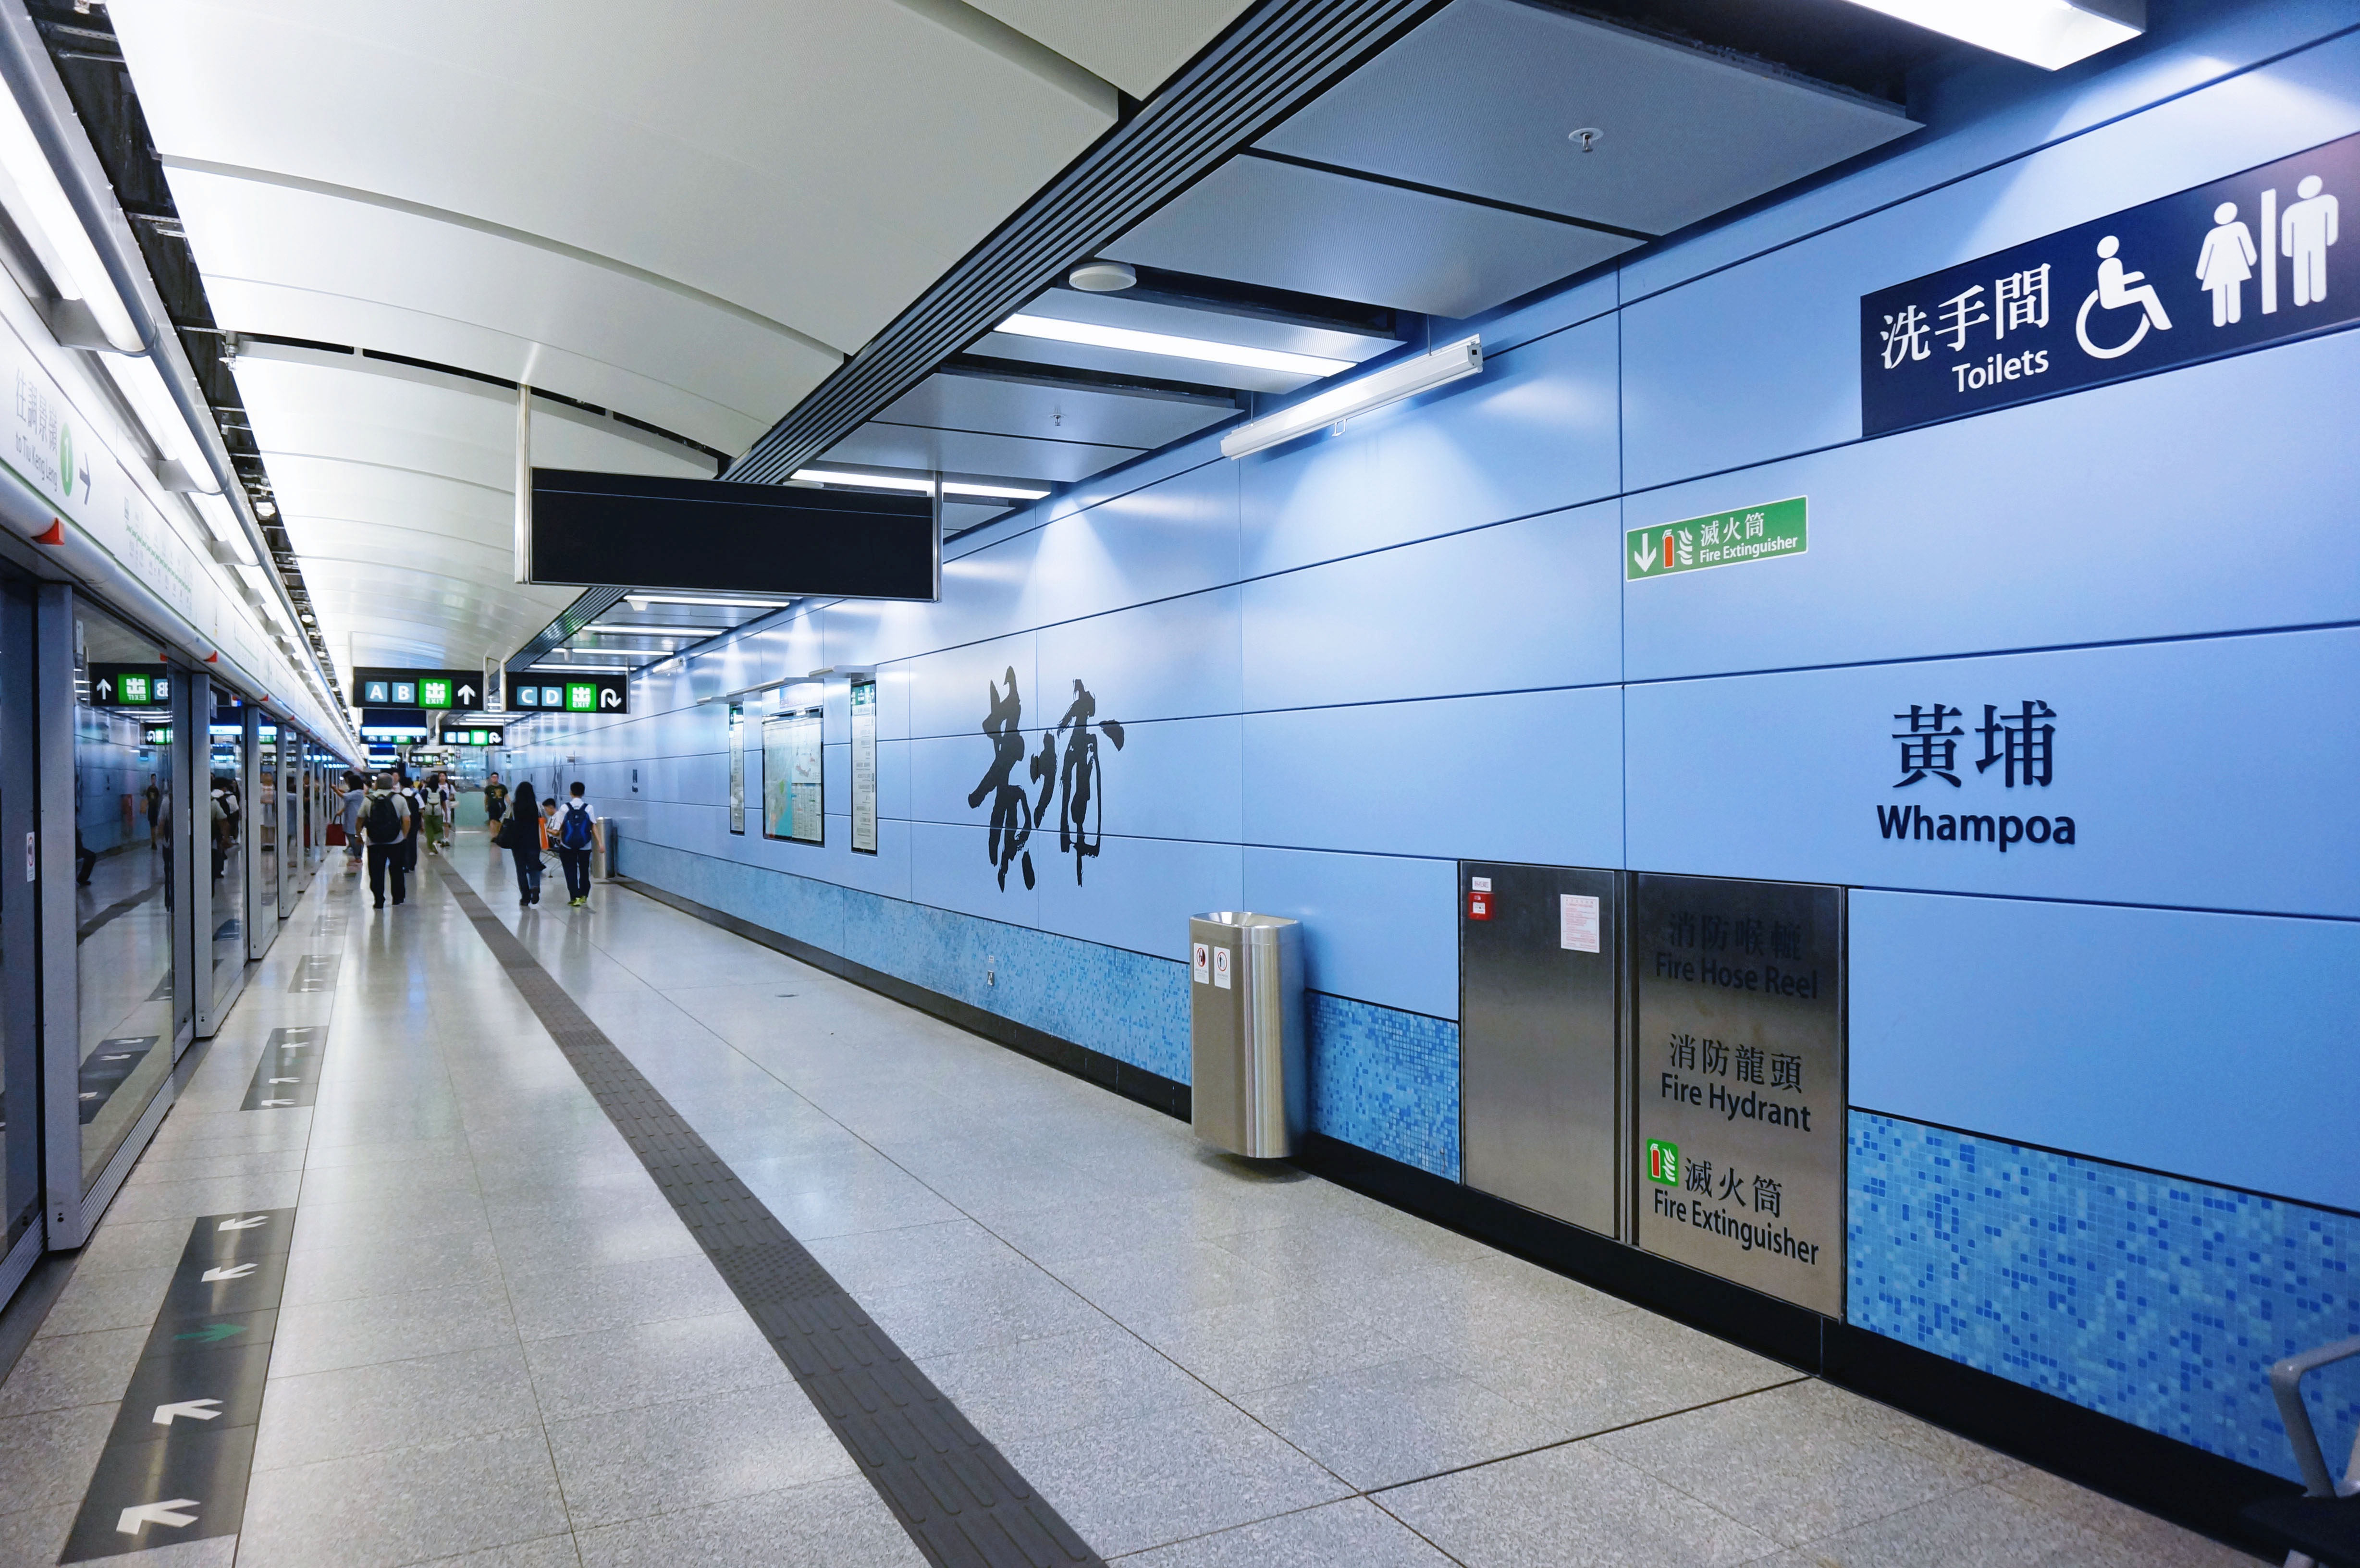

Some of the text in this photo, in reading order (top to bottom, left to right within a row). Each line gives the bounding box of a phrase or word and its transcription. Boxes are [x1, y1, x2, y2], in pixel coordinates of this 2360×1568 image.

[1880, 263, 2051, 369] 洗手間
[1952, 350, 2049, 392] Toilets
[65, 437, 69, 482] 1
[1700, 512, 1764, 547] 滅火筒
[1700, 536, 1798, 563] Fire Extinguisher
[369, 685, 410, 700] A B
[521, 689, 559, 704] C D
[1892, 699, 2057, 788] 黃埔
[1877, 805, 2076, 853] Whampoa
[1656, 951, 1817, 999] Fire Hose Reel
[1670, 1033, 1802, 1094] 消防龍頭
[1661, 1072, 1811, 1132] Fire Hydrant
[1684, 1157, 1782, 1219] 滅火筒
[1654, 1188, 1819, 1265] Fire Extinguisher
